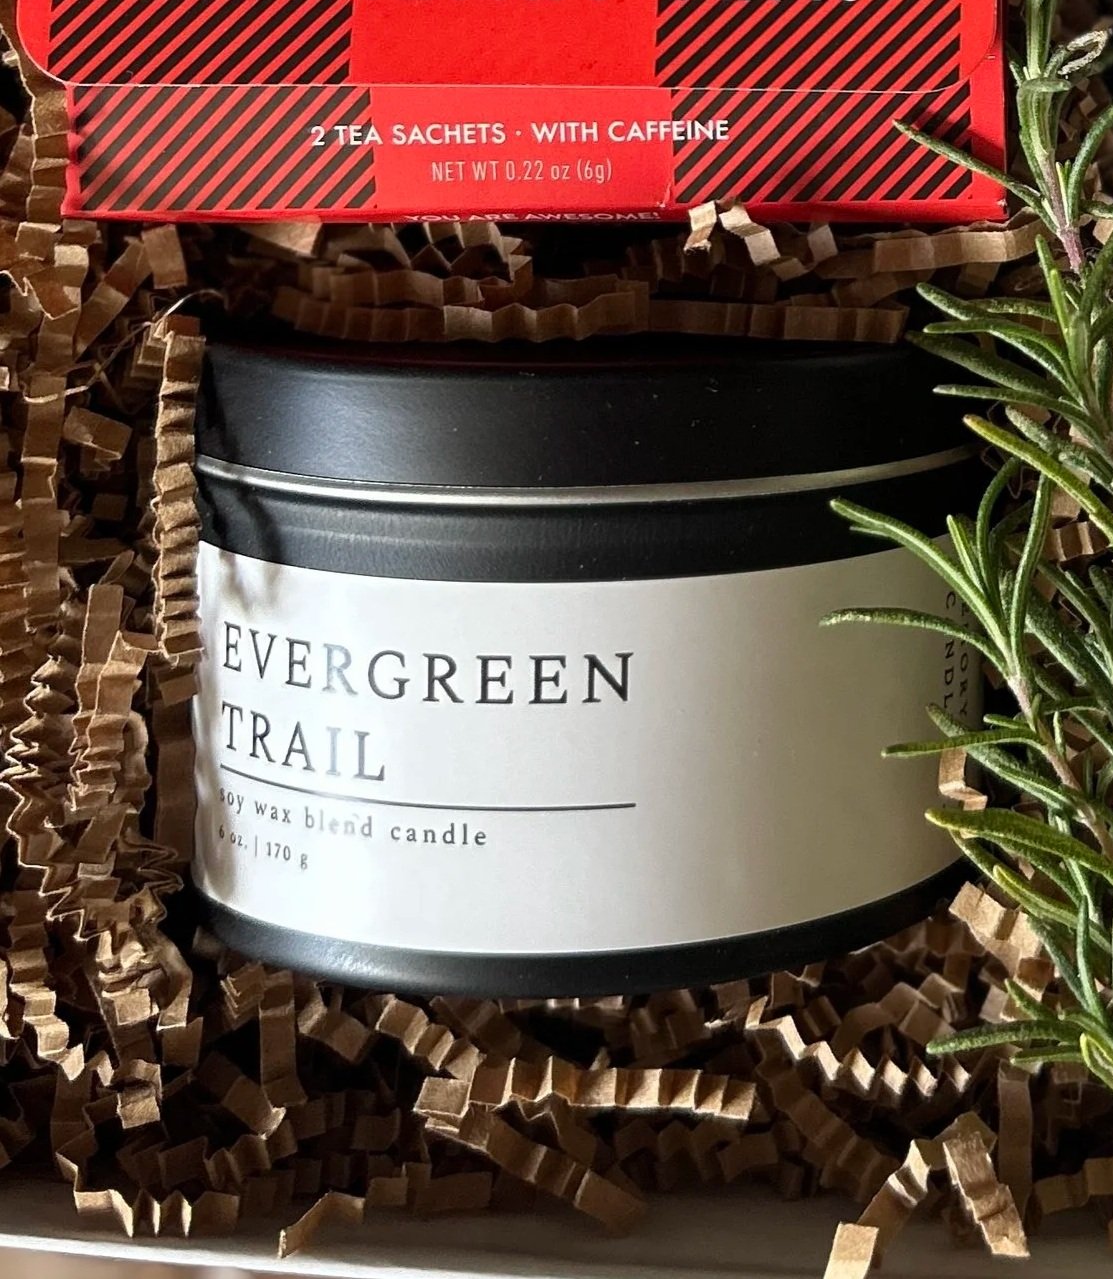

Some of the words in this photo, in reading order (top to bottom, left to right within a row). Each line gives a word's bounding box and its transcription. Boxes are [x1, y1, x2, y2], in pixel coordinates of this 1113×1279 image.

[310, 126, 326, 147] 2
[333, 123, 384, 146] TEA
[391, 122, 507, 146] SACHETS
[530, 121, 600, 144] WITH
[607, 119, 730, 143] CAFFEINE
[431, 160, 464, 183] NET
[470, 160, 499, 182] WT
[505, 160, 545, 182] 0.22
[550, 165, 570, 181] oz
[576, 158, 613, 184] (6g)
[404, 213, 461, 221] YOU
[468, 212, 519, 221] ARE
[525, 211, 661, 221] AWESOME!
[223, 621, 634, 705] EVERGREEN
[221, 700, 386, 782] TRAIL
[219, 787, 245, 815] soy
[254, 800, 292, 824] wax
[305, 806, 373, 838] blend
[390, 822, 488, 848] candle
[266, 840, 292, 862] 170
[300, 852, 309, 870] g
